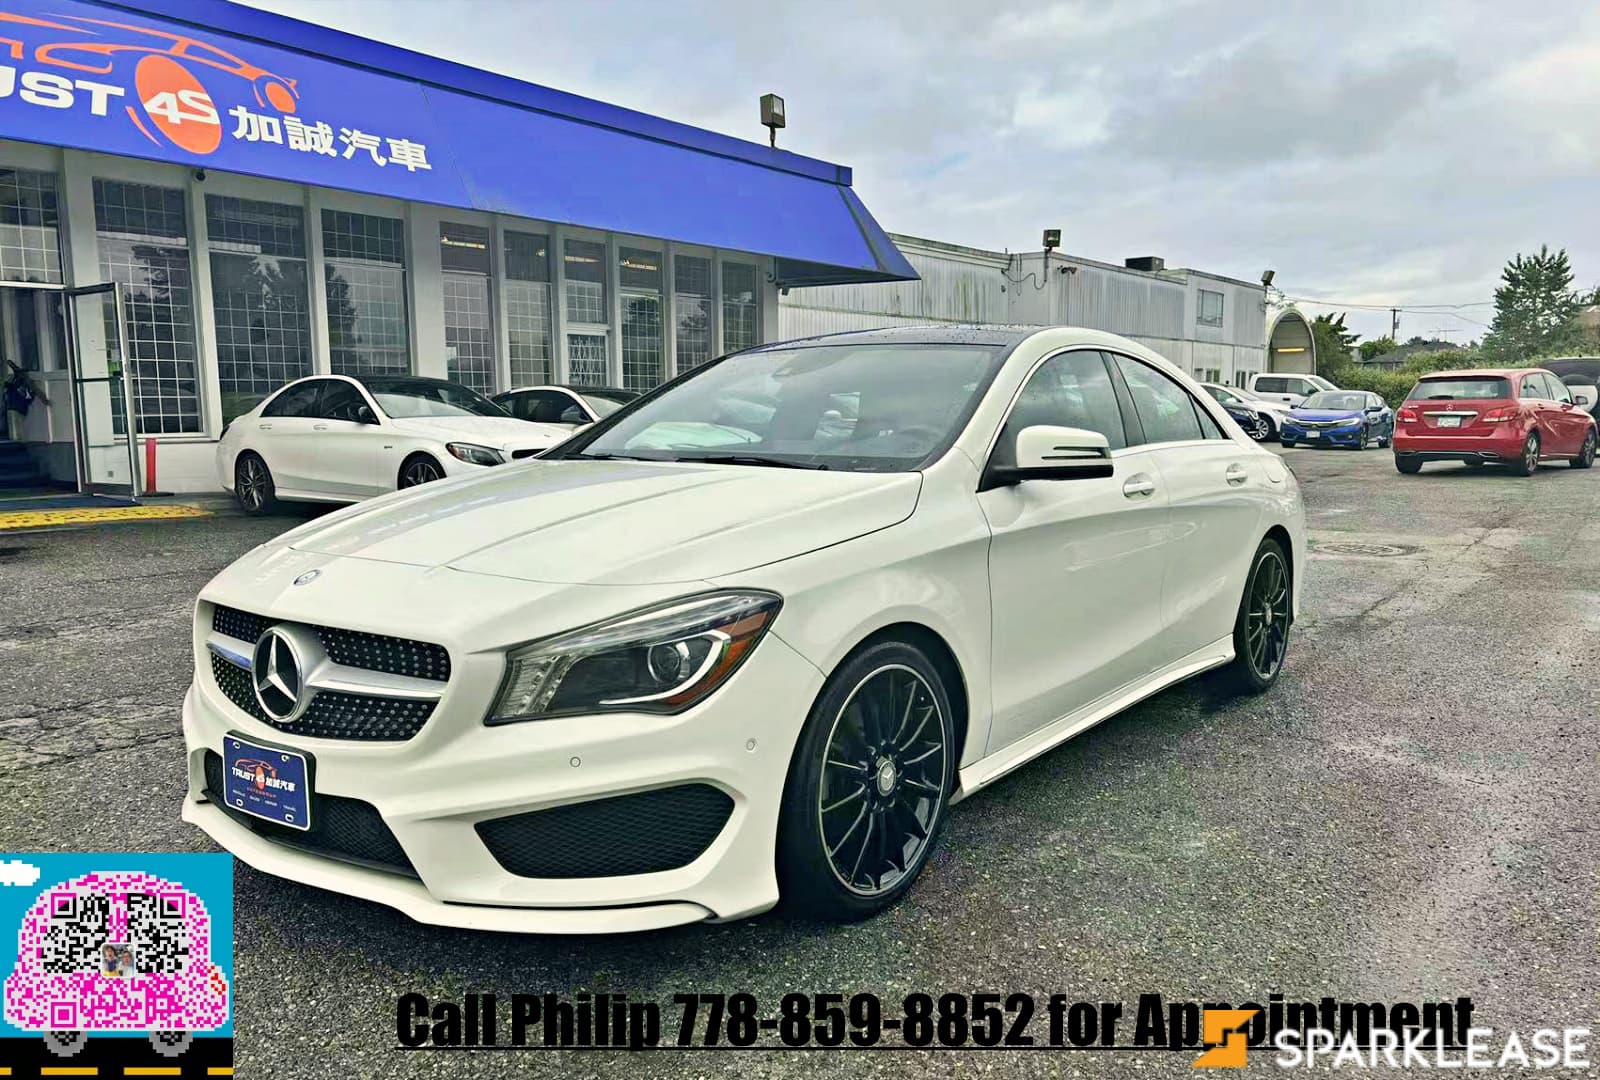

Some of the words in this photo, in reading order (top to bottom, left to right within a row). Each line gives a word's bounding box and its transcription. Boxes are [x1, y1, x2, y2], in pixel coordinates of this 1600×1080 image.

[143, 89, 219, 124] 4S
[229, 106, 432, 172] 加誠汽車
[232, 767, 255, 782] TRUST
